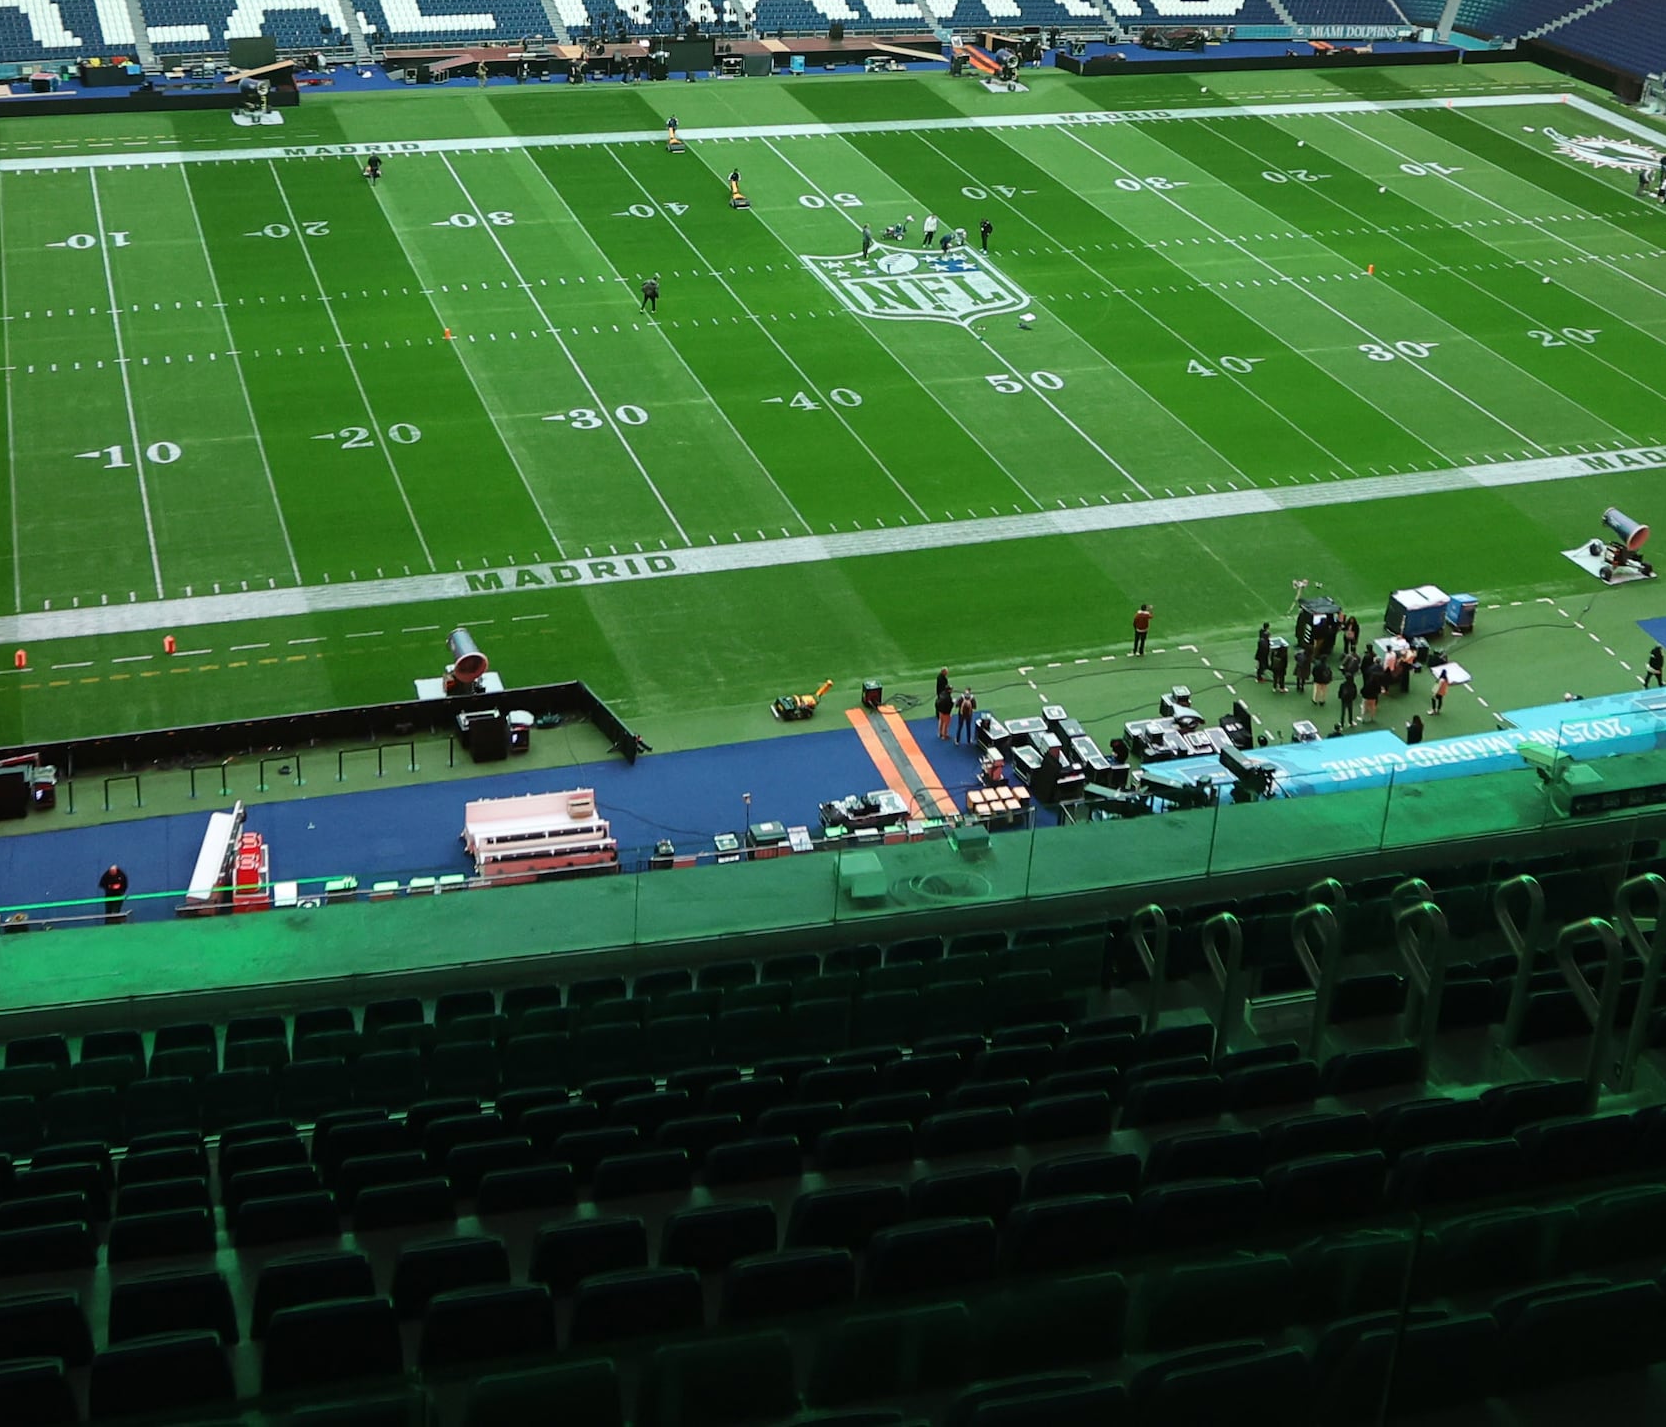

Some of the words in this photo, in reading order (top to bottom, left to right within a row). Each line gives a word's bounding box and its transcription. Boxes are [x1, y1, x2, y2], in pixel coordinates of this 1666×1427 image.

[1310, 25, 1343, 38] MIAMI
[1345, 25, 1397, 38] DOLPHINS
[1058, 111, 1171, 122] MADRID
[283, 143, 420, 156] MADRID
[1262, 169, 1317, 184] 20
[1400, 162, 1451, 177] 10
[961, 184, 1016, 200] 40
[1115, 176, 1174, 191] 30
[629, 201, 690, 218] 40
[798, 192, 864, 209] 50
[449, 210, 515, 228] 30
[263, 220, 330, 239] 20
[66, 231, 131, 250] 10
[860, 276, 1009, 312] NFL
[1528, 327, 1595, 347] 20
[1357, 340, 1431, 363] 30
[1186, 355, 1256, 378] 40
[985, 371, 1065, 395] 50
[788, 387, 864, 412] 40
[567, 404, 650, 430] 30
[338, 423, 422, 451] 20
[102, 441, 182, 469] 10
[466, 555, 678, 593] MADRID
[1562, 717, 1632, 744] 2025
[1406, 734, 1517, 768] MADRID
[1320, 753, 1408, 781] GAME
